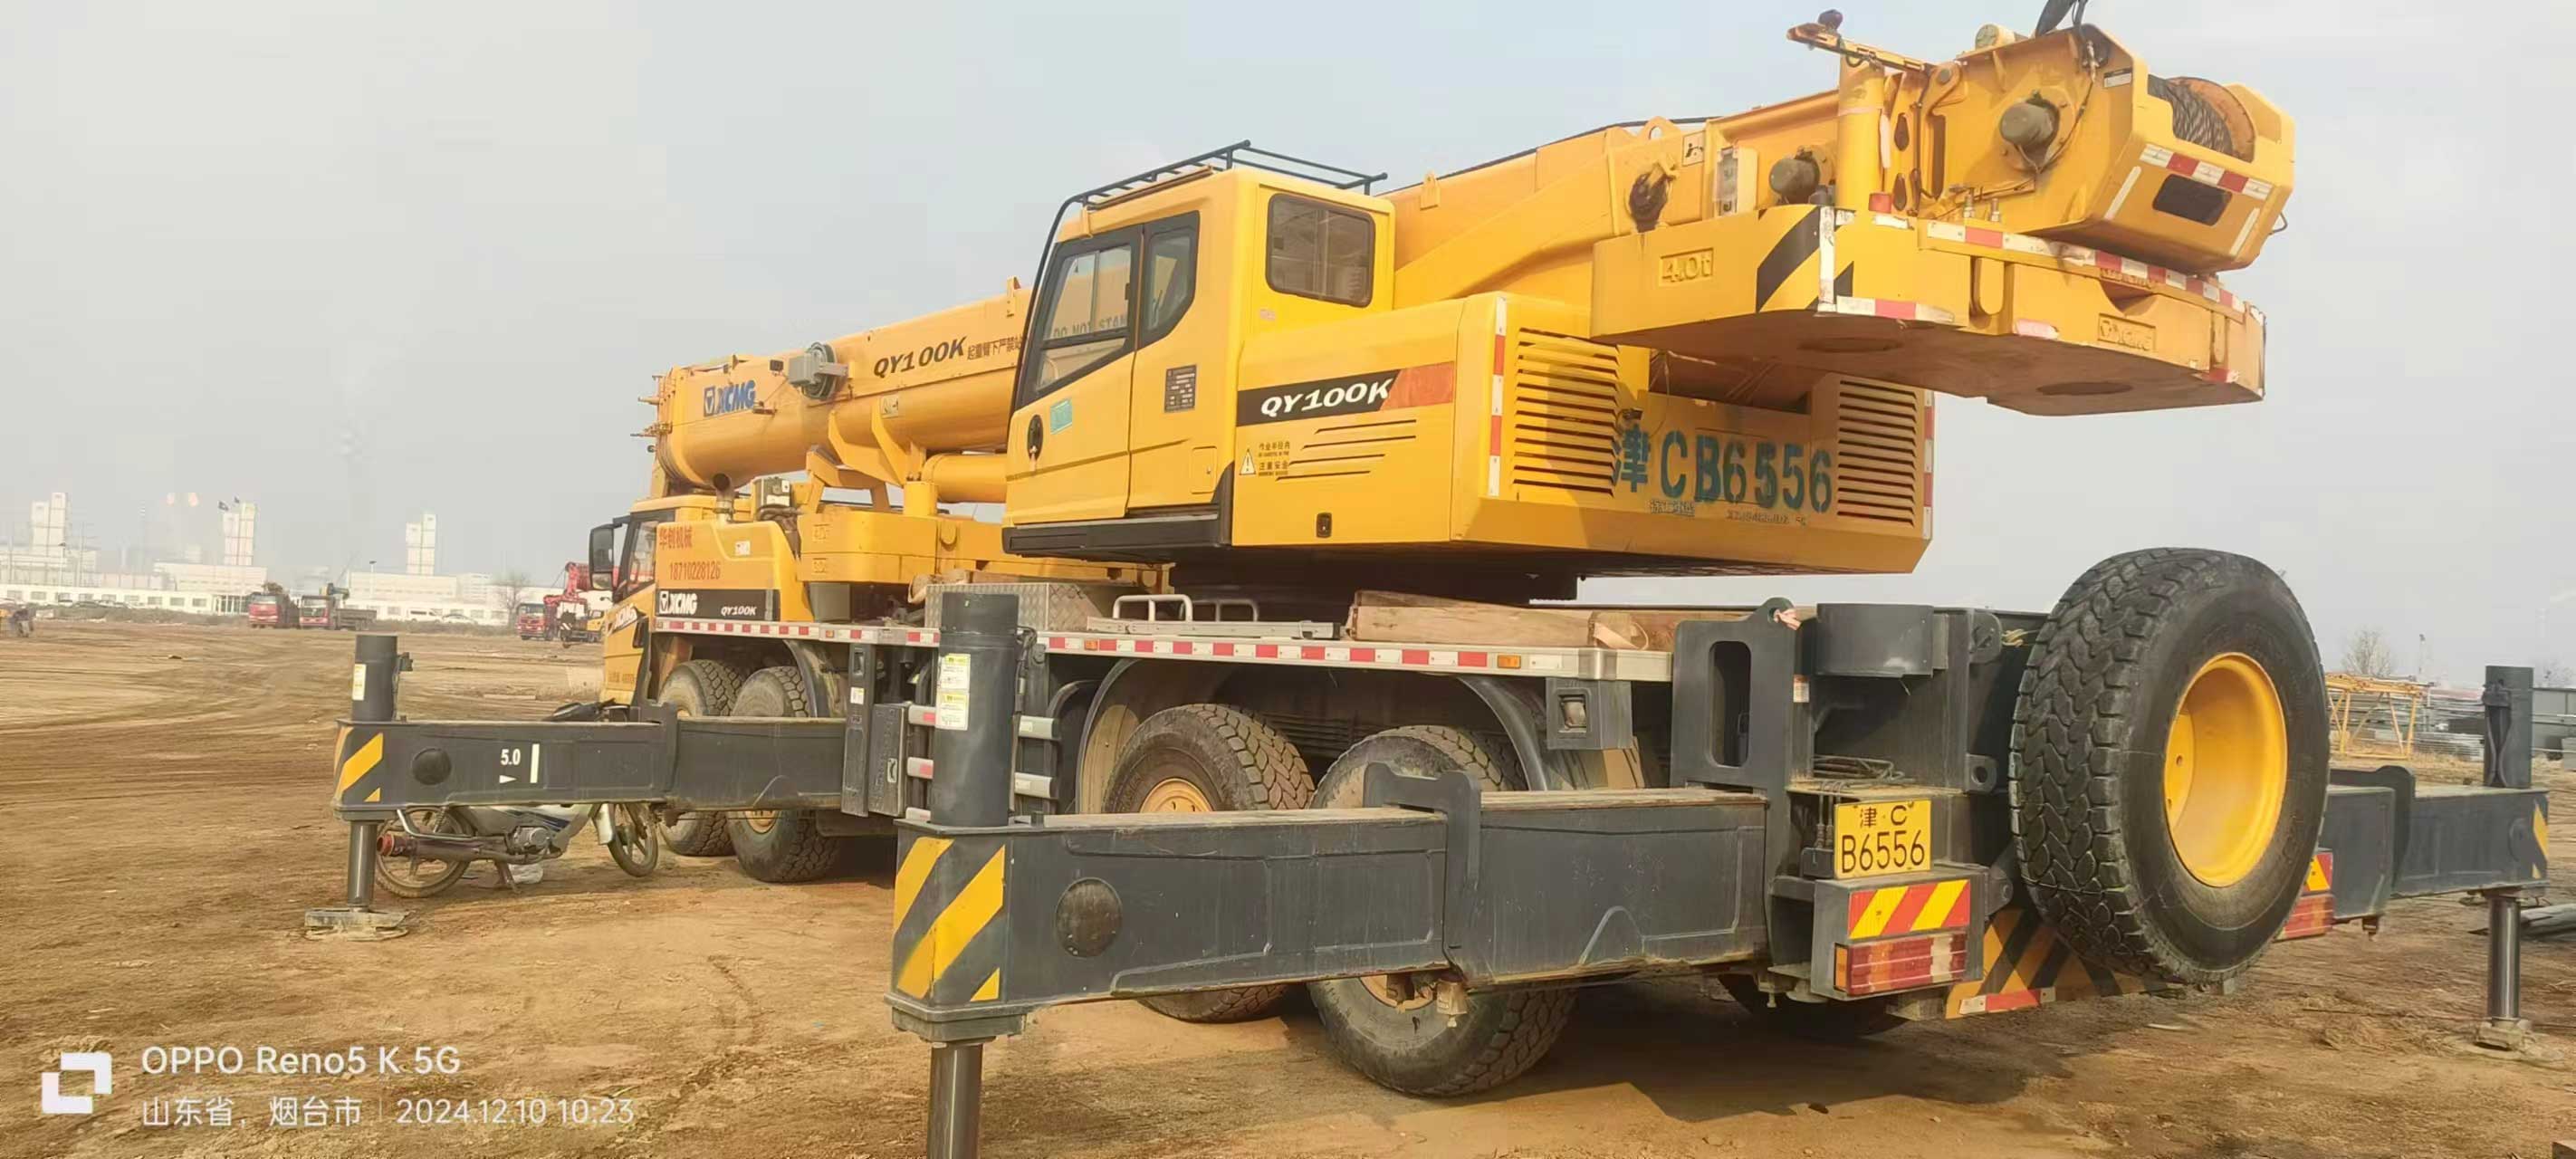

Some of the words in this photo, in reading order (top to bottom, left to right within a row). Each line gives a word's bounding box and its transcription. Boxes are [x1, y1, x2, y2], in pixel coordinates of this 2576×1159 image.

[874, 336, 967, 378] QY100K
[713, 379, 756, 415] XCMG
[1260, 378, 1393, 417] QY100K
[670, 561, 721, 580] 18710228126
[669, 592, 698, 615] XCMG
[720, 606, 757, 616] QY100K
[500, 749, 521, 765] 5.0
[1842, 829, 1925, 874] B6556
